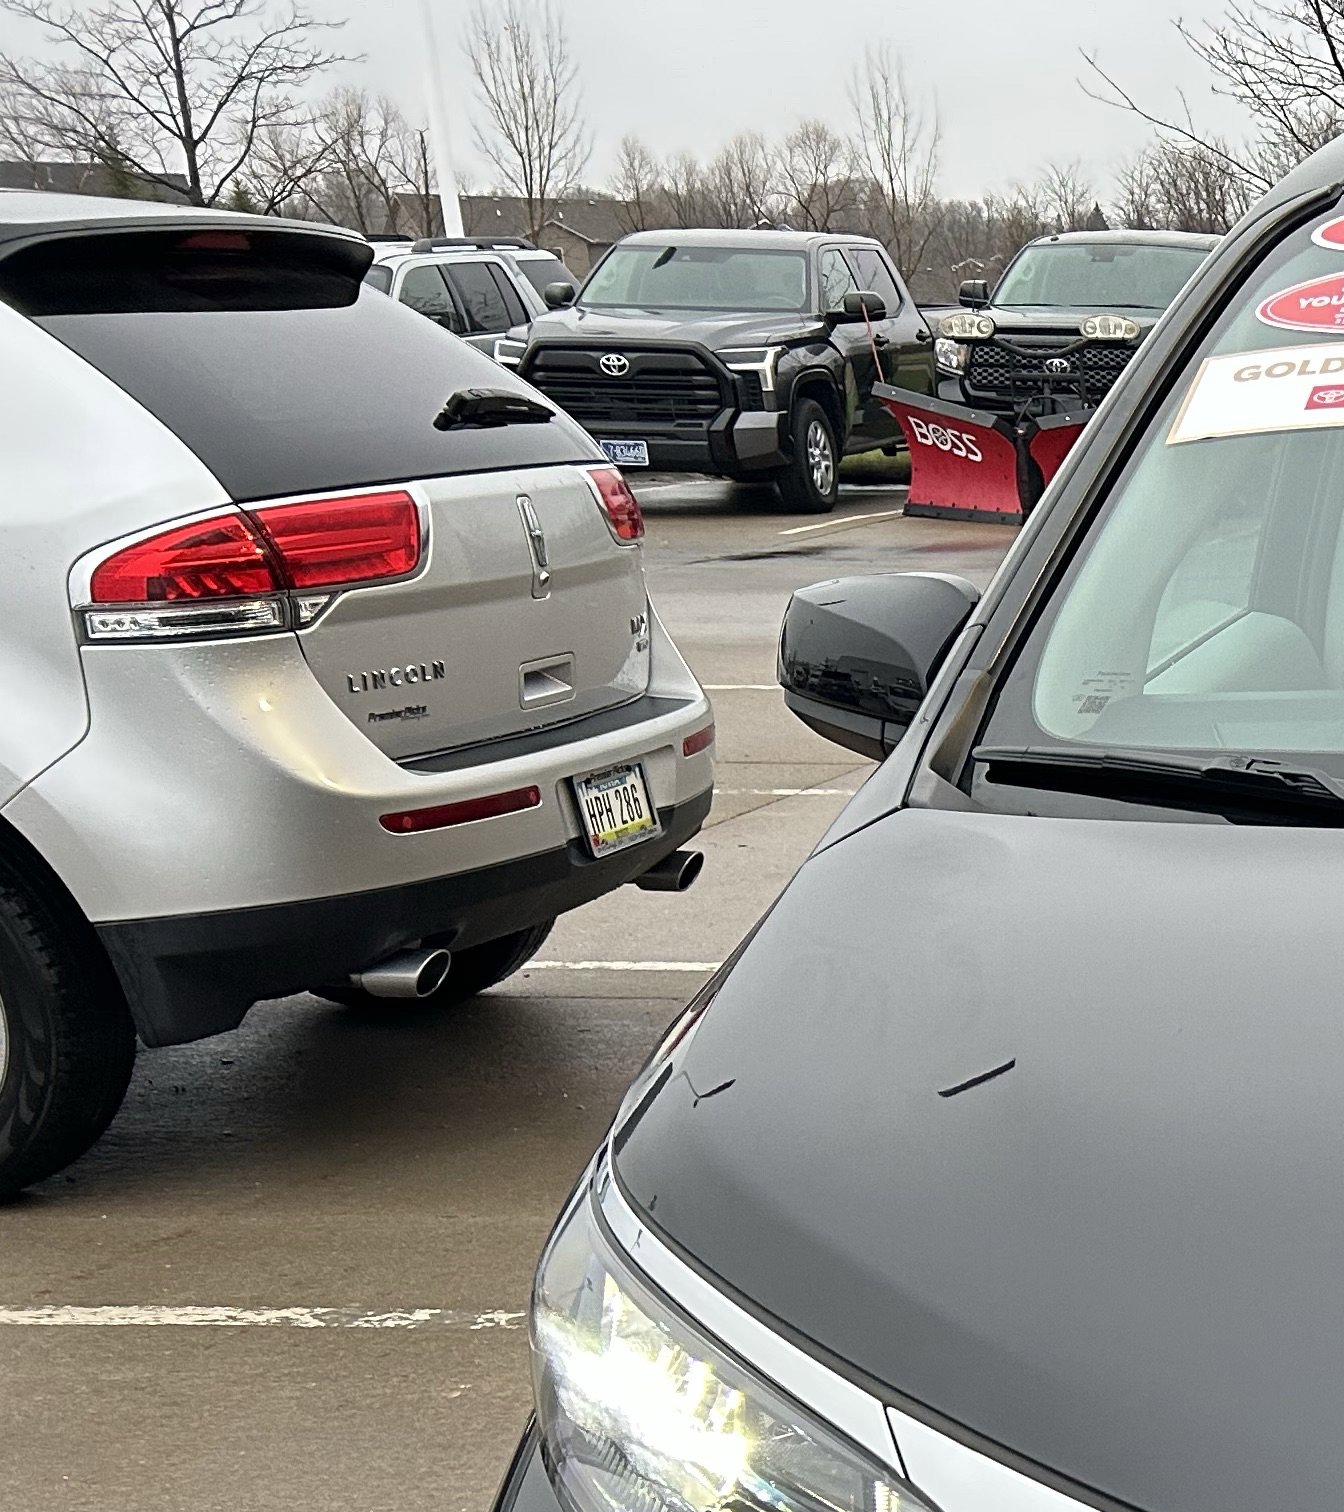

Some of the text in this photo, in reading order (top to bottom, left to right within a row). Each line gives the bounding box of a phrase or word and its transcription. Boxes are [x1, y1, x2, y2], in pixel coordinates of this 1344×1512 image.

[907, 415, 983, 462] BOSS
[347, 660, 445, 693] LINCOLN
[585, 783, 643, 835] HPH 286
